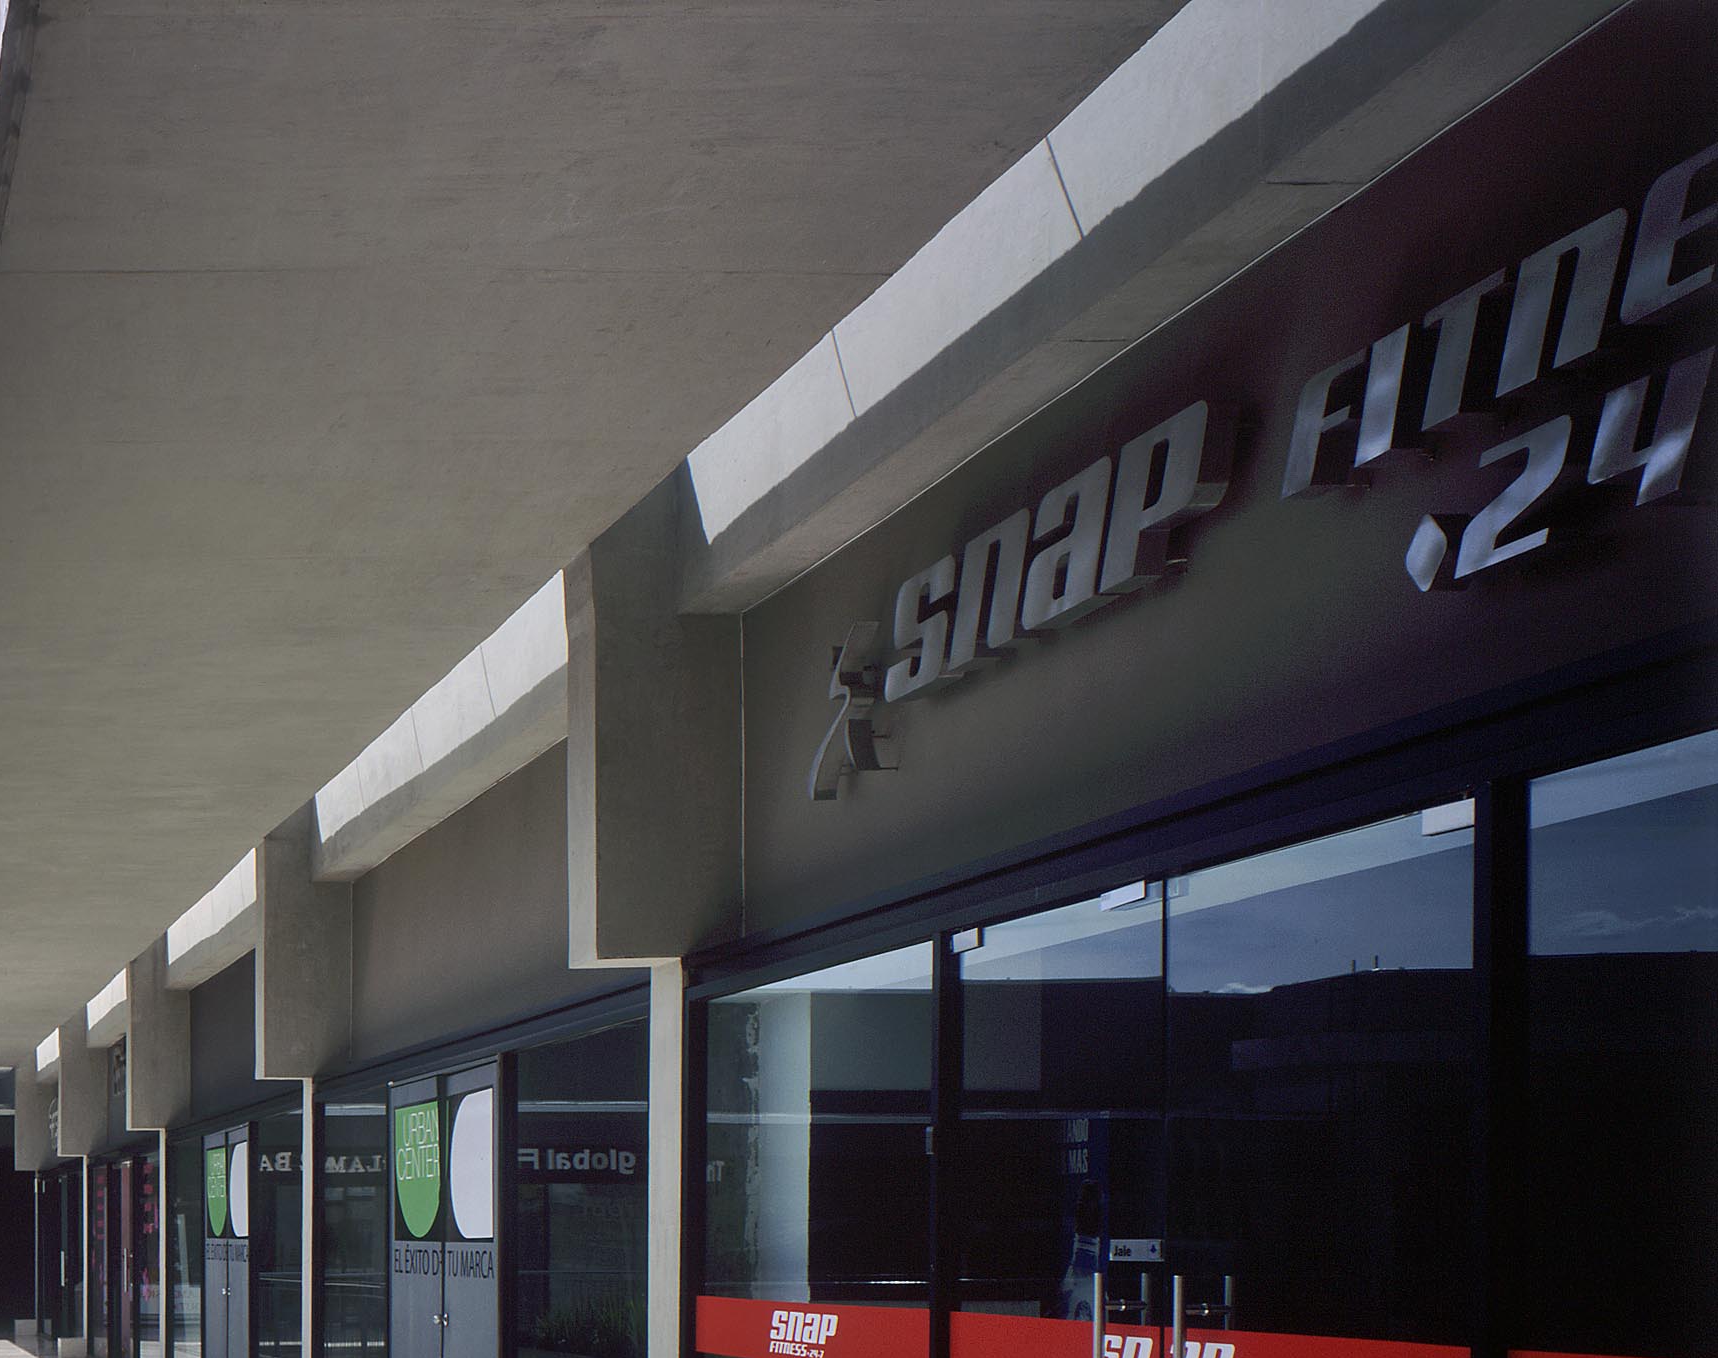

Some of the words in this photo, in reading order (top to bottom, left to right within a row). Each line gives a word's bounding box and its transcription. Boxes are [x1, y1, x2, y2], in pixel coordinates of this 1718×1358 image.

[1113, 1244, 1132, 1257] Jale
[394, 1249, 403, 1273] EL
[446, 1250, 459, 1277] TU
[460, 1251, 495, 1279] MARCA
